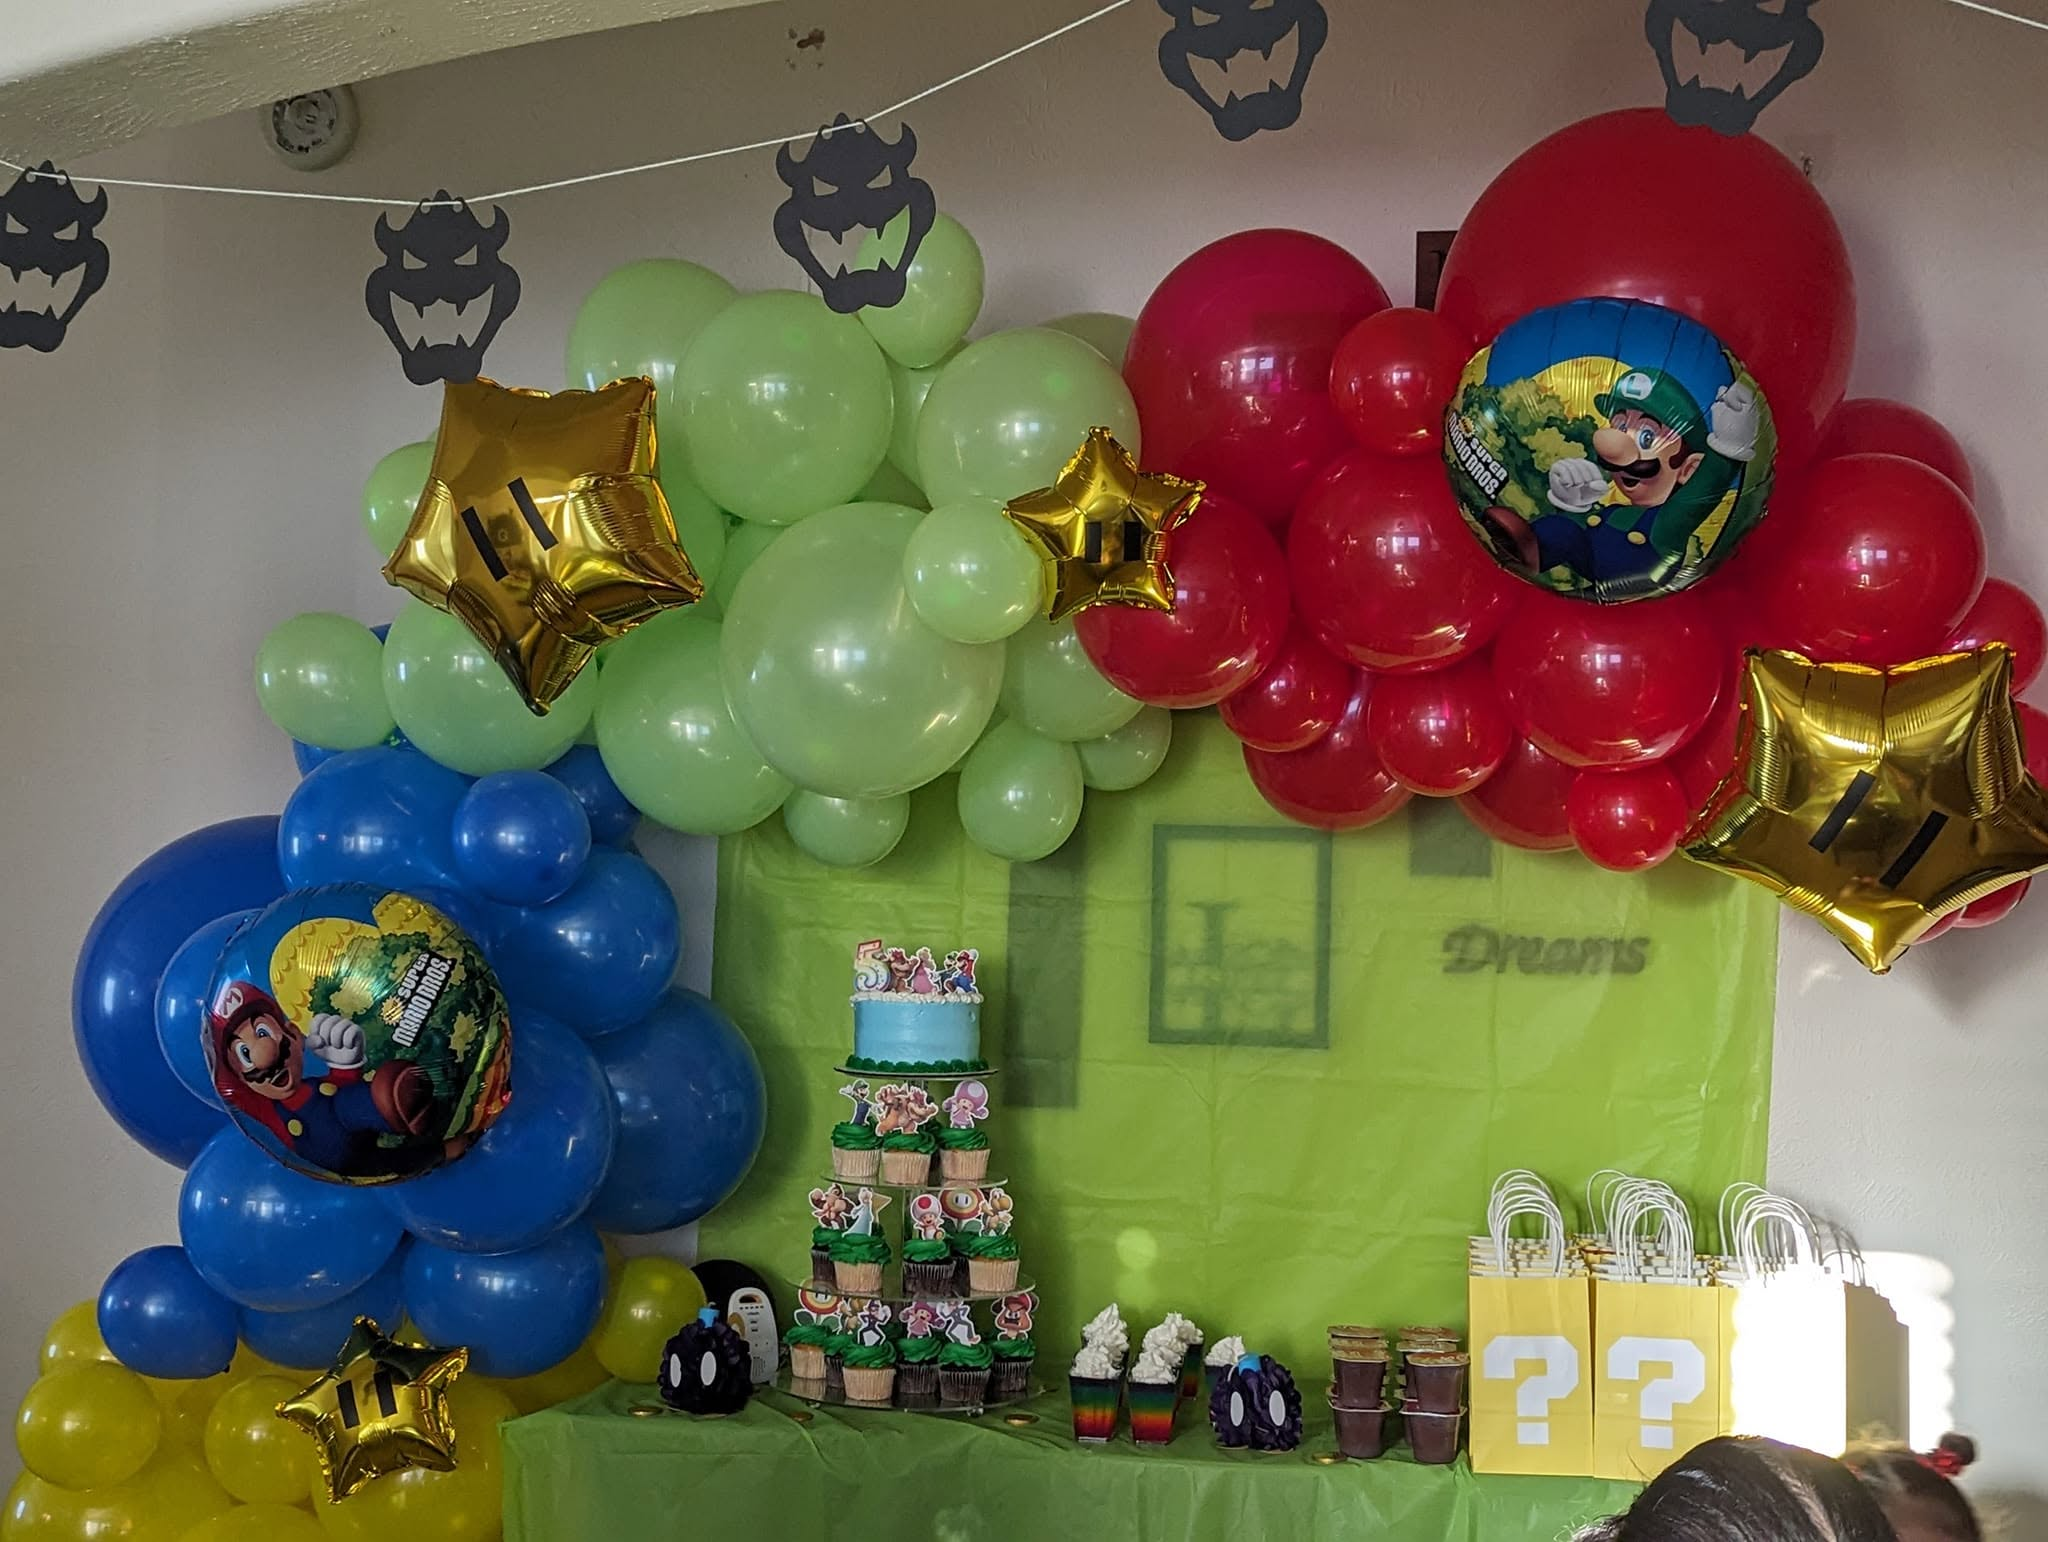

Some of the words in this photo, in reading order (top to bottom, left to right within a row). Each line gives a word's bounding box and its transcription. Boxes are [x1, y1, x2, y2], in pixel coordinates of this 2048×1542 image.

[1626, 375, 1641, 395] L
[1464, 454, 1500, 500] BROS.
[1469, 437, 1508, 481] SUPER
[854, 939, 892, 992] 5
[1442, 923, 1650, 976] Dreams
[397, 952, 430, 999] SUPER
[223, 990, 242, 1016] M
[391, 994, 432, 1048] MARIO
[415, 957, 453, 1001] BROS.
[1483, 1336, 1579, 1446] ?
[1607, 1336, 1706, 1450] ?
